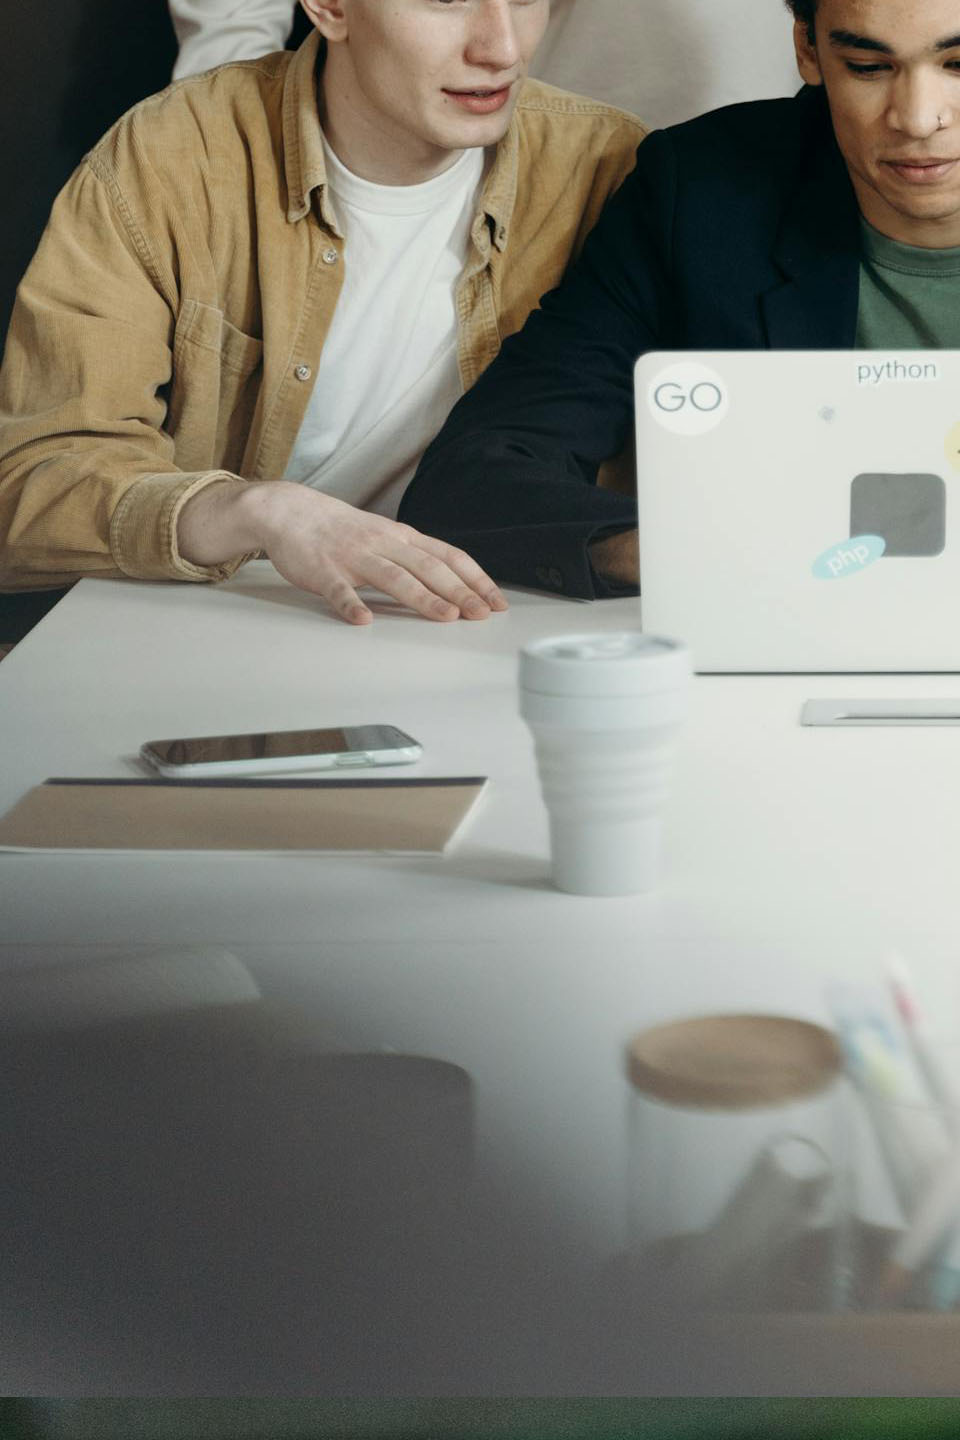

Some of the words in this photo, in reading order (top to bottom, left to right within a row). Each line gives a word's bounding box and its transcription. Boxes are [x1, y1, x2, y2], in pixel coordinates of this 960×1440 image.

[857, 360, 937, 383] python
[653, 382, 722, 412] GO
[827, 544, 870, 576] php
